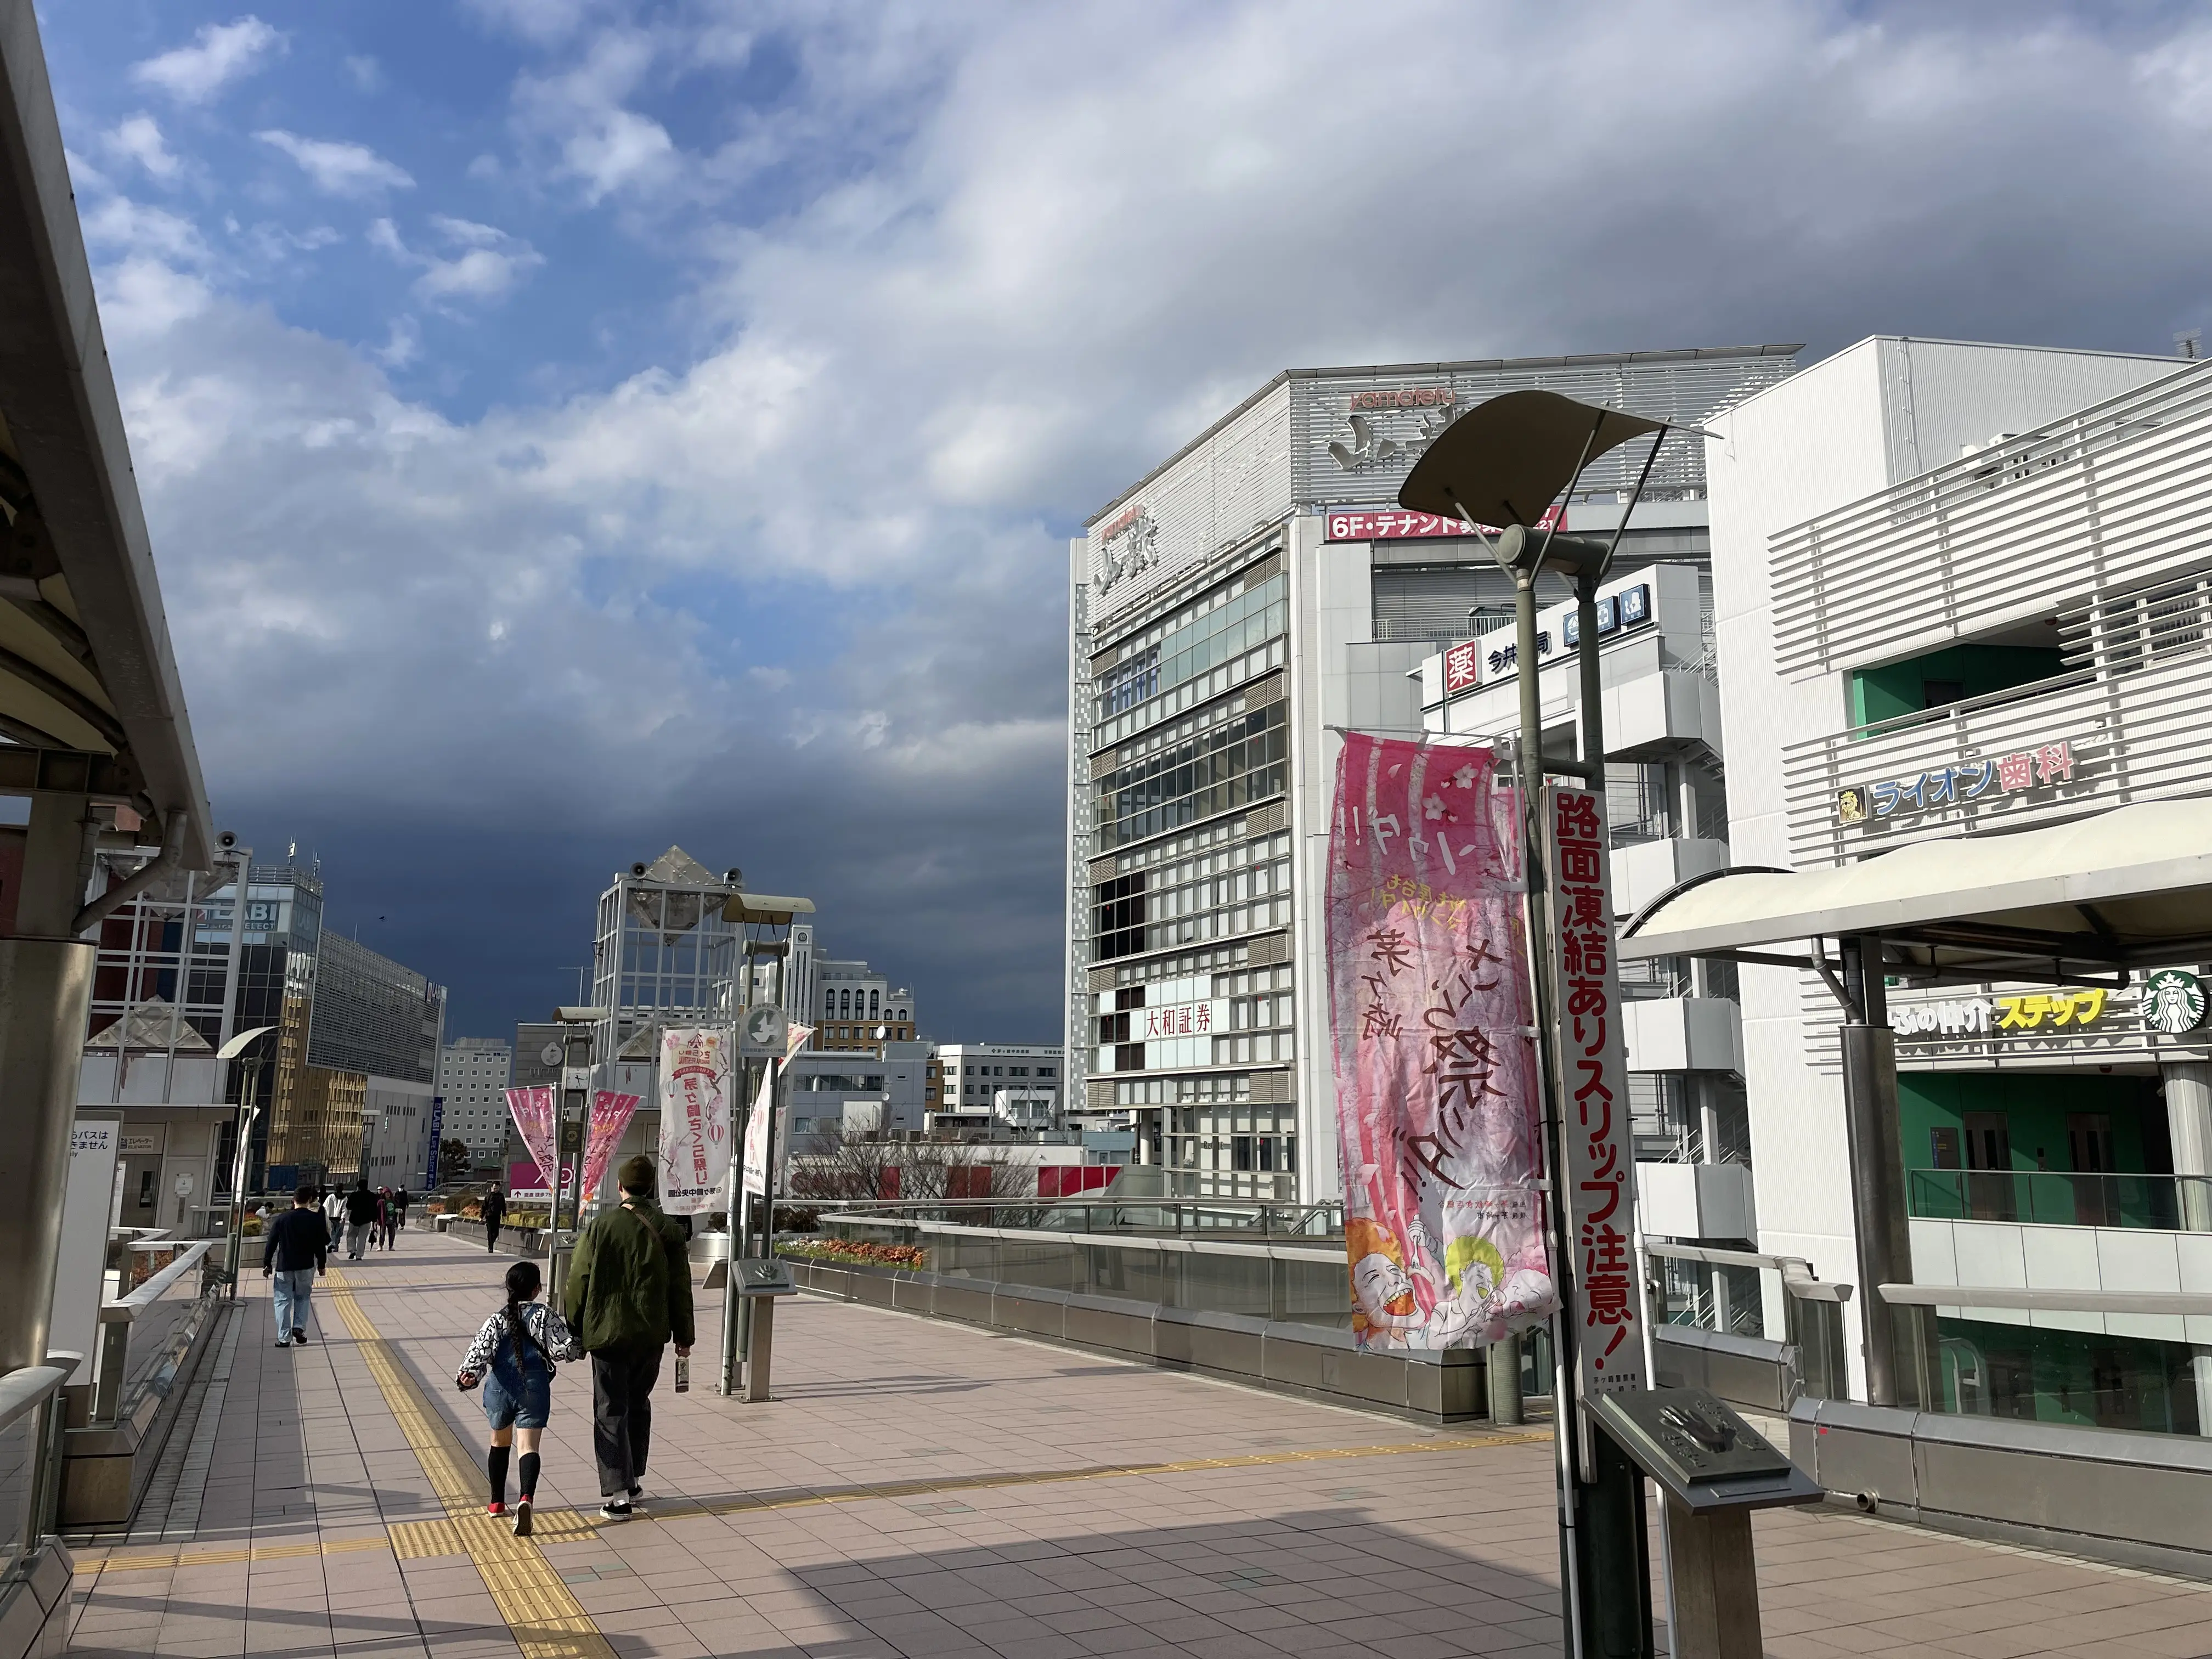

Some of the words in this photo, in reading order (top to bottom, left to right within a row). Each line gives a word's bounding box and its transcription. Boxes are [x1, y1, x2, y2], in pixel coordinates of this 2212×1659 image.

[1350, 386, 1456, 411] yamatetu
[1447, 645, 1474, 688] 薬
[1488, 631, 1552, 673] 今井局
[1872, 741, 2074, 816] ライオン歯科
[1147, 1004, 1210, 1037] 大和証券
[1999, 988, 2107, 1029] ステップ
[432, 1110, 441, 1131] LABI
